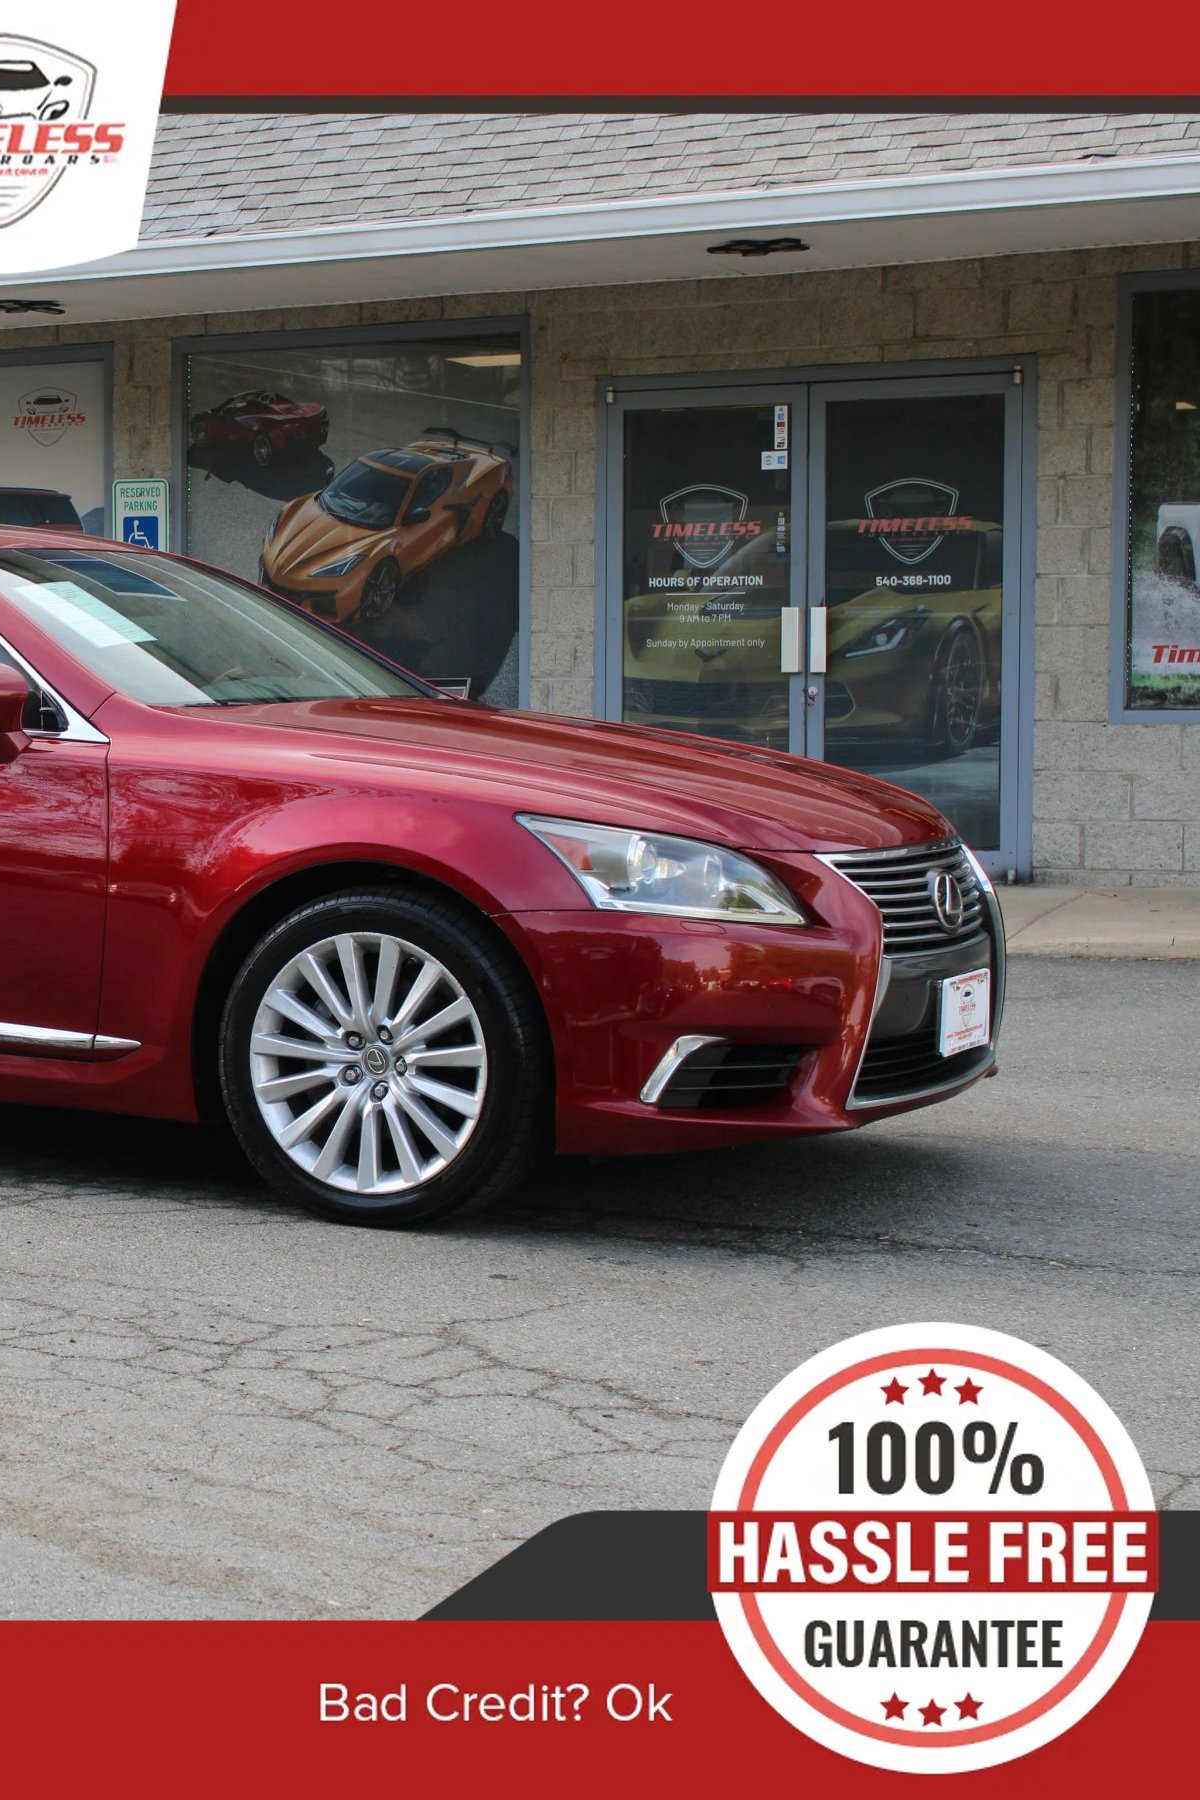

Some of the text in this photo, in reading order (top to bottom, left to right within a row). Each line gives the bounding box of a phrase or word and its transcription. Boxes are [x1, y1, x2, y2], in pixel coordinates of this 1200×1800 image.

[120, 486, 160, 498] RESERVED
[124, 501, 158, 512] PARKING
[651, 521, 762, 538] TIMELESS
[858, 516, 973, 533] TIMELESS
[648, 575, 763, 588] HOURS OF OPERATION
[875, 574, 951, 587] 540-368-1100
[667, 602, 699, 612] Monday
[706, 601, 744, 611] Saturday
[679, 614, 731, 623] 9 AM to 7 PM
[646, 637, 765, 649] Sunday by Appointment only
